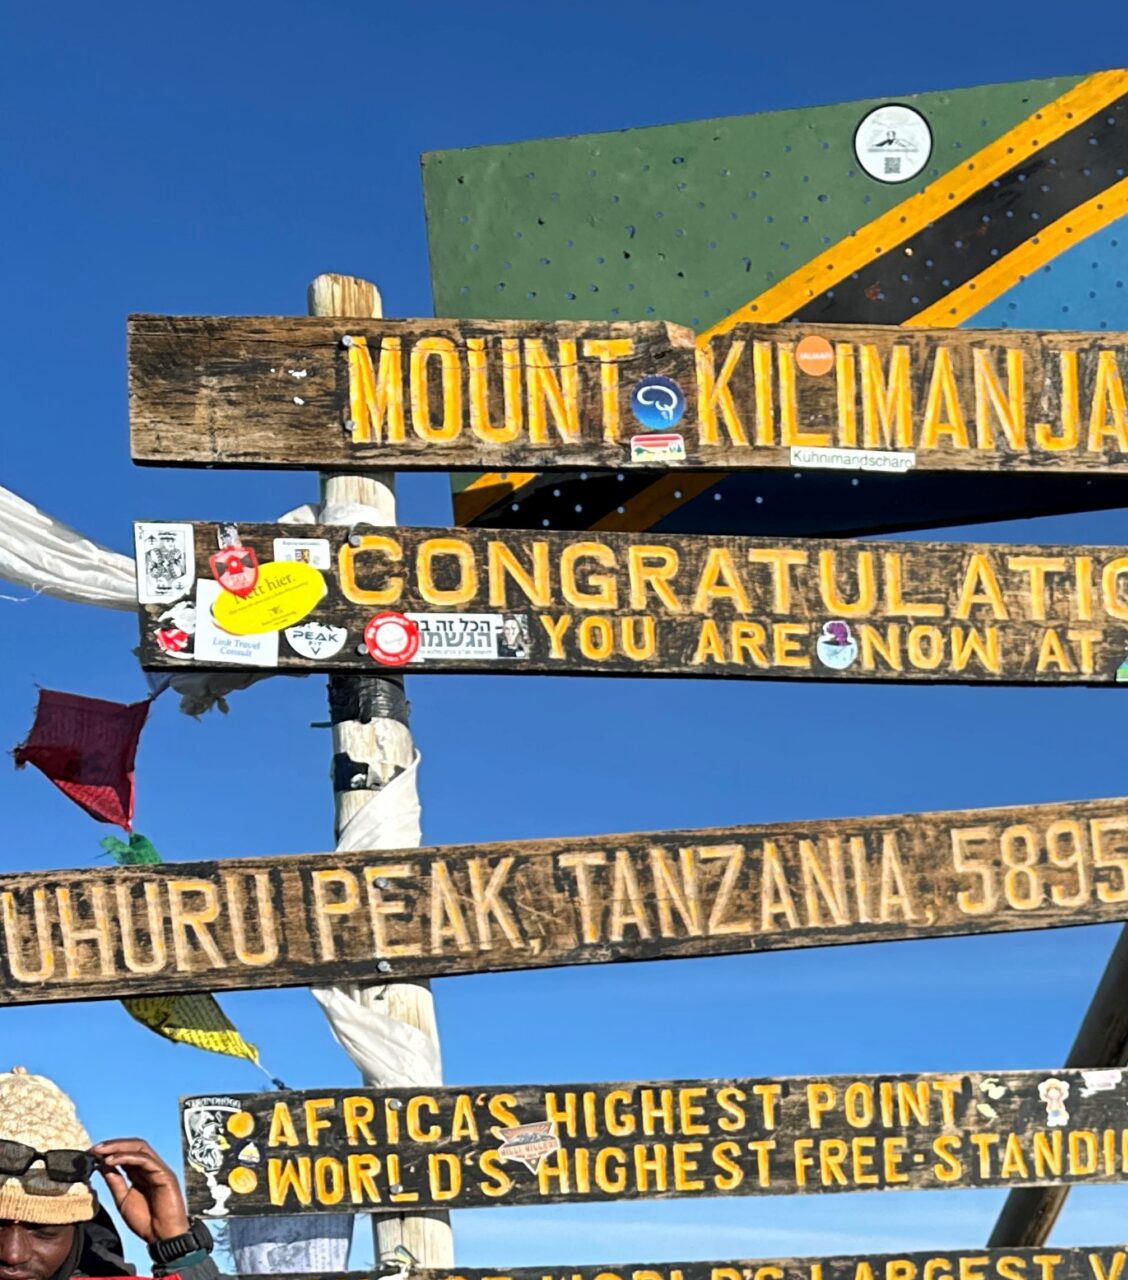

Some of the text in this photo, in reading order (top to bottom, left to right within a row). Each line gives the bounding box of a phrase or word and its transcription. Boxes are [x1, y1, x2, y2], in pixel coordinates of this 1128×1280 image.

[348, 336, 632, 445] MOUNT
[293, 630, 339, 643] PEAK
[538, 614, 1103, 675] YOU ARE NOW AT
[2, 872, 279, 983] UHURU
[311, 855, 544, 962] PEAK,
[558, 832, 934, 943] TANZANIA,
[267, 1079, 964, 1148] AFRICA'S HIGHEST POINT
[267, 1149, 515, 1206] WORLD'S
[538, 1139, 776, 1195] HIGHEST
